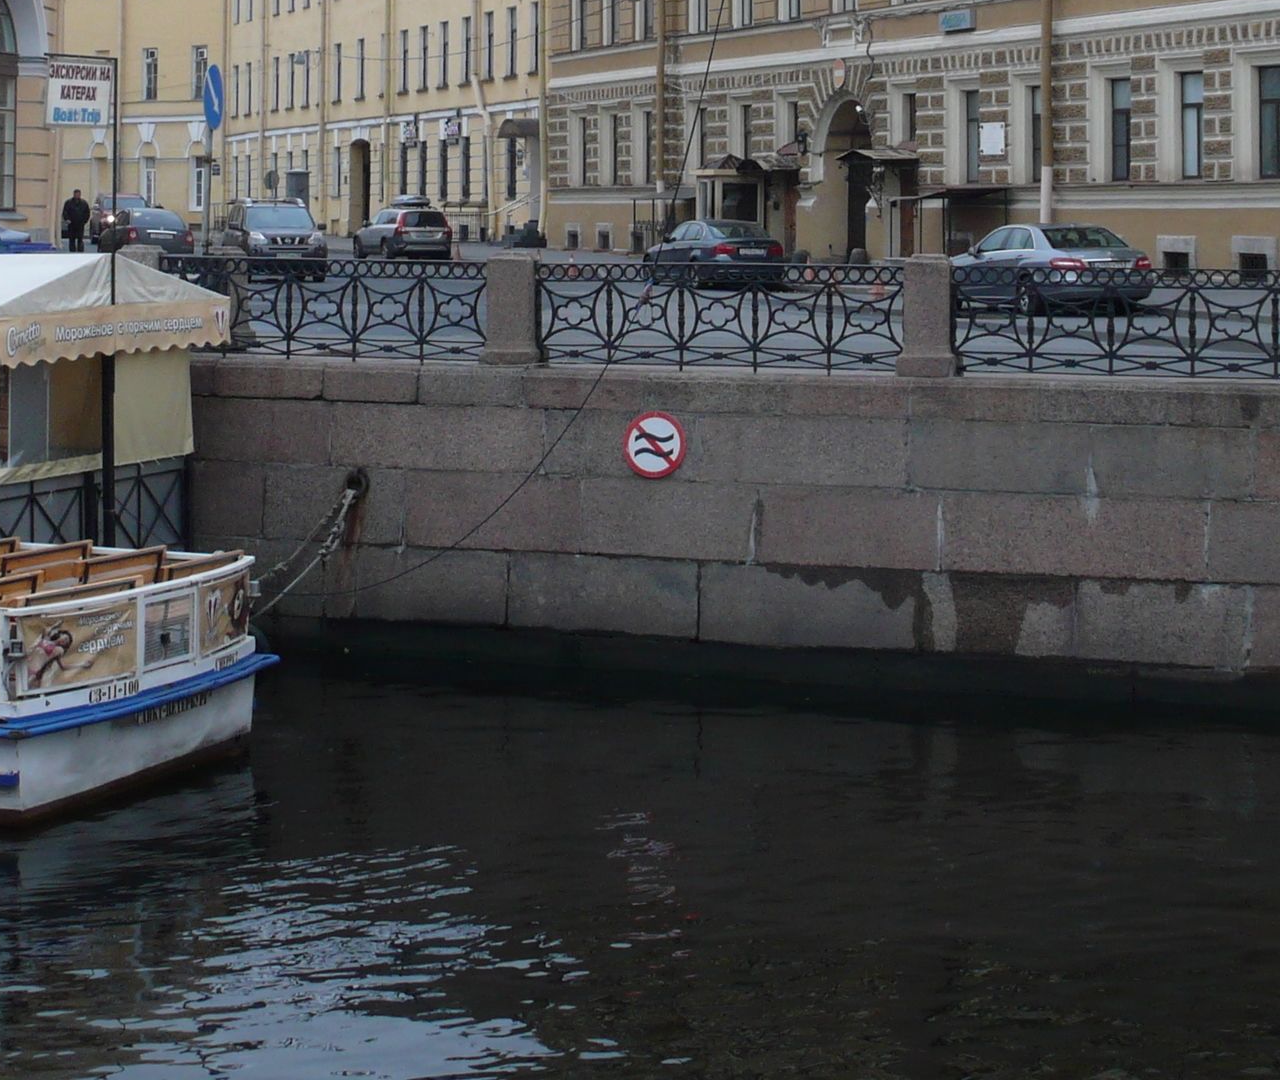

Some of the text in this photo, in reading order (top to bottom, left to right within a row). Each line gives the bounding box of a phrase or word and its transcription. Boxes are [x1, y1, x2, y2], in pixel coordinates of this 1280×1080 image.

[49, 64, 111, 81] ЭКСКУРСИИ НА
[60, 85, 97, 101] КАТЕРАХ
[53, 107, 101, 124] Boat Trip
[55, 316, 203, 343] Мороженое с горячим сердцем
[6, 323, 41, 357] Cornetto
